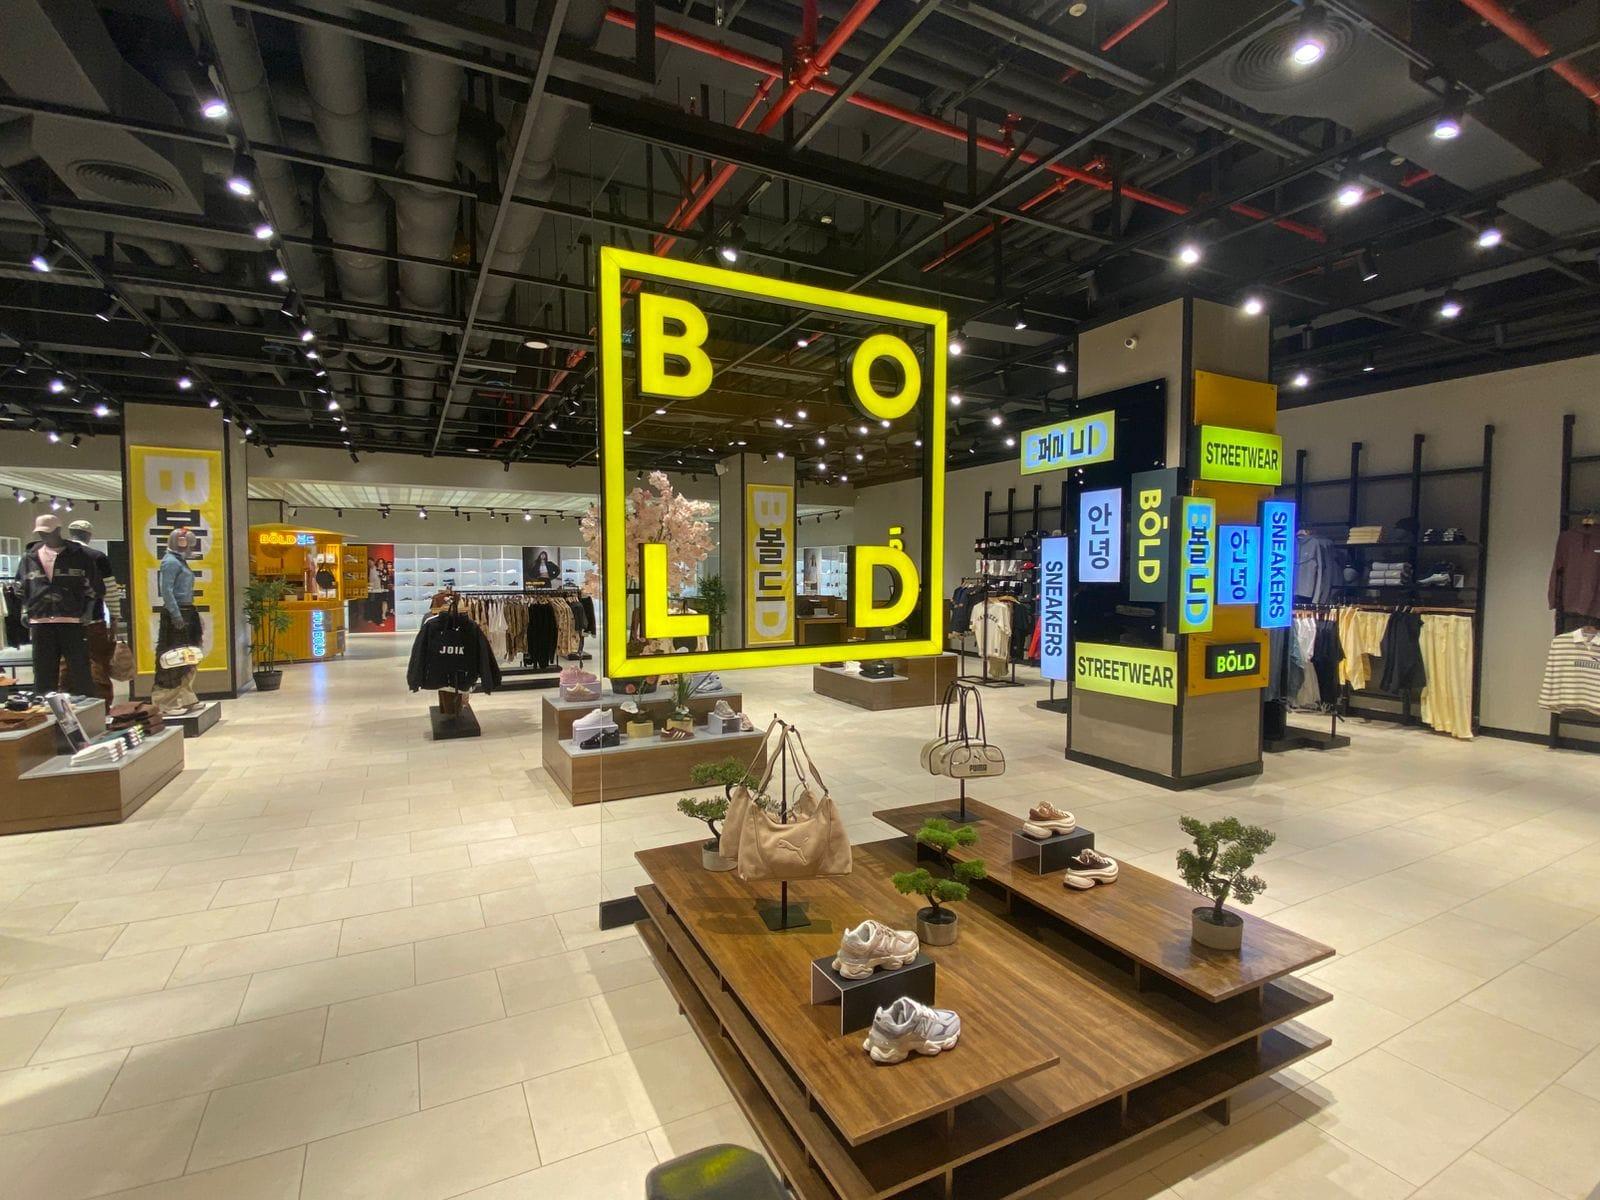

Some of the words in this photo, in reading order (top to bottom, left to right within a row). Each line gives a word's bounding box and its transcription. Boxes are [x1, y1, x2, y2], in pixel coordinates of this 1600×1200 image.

[1206, 441, 1279, 470] STREETWEAR
[1088, 503, 1112, 570] 안녕
[1230, 529, 1250, 600] 안녕
[1268, 511, 1288, 619] SNEAKERS
[1044, 560, 1063, 657] SNEAKERS
[1078, 656, 1174, 688] STREETWEAR
